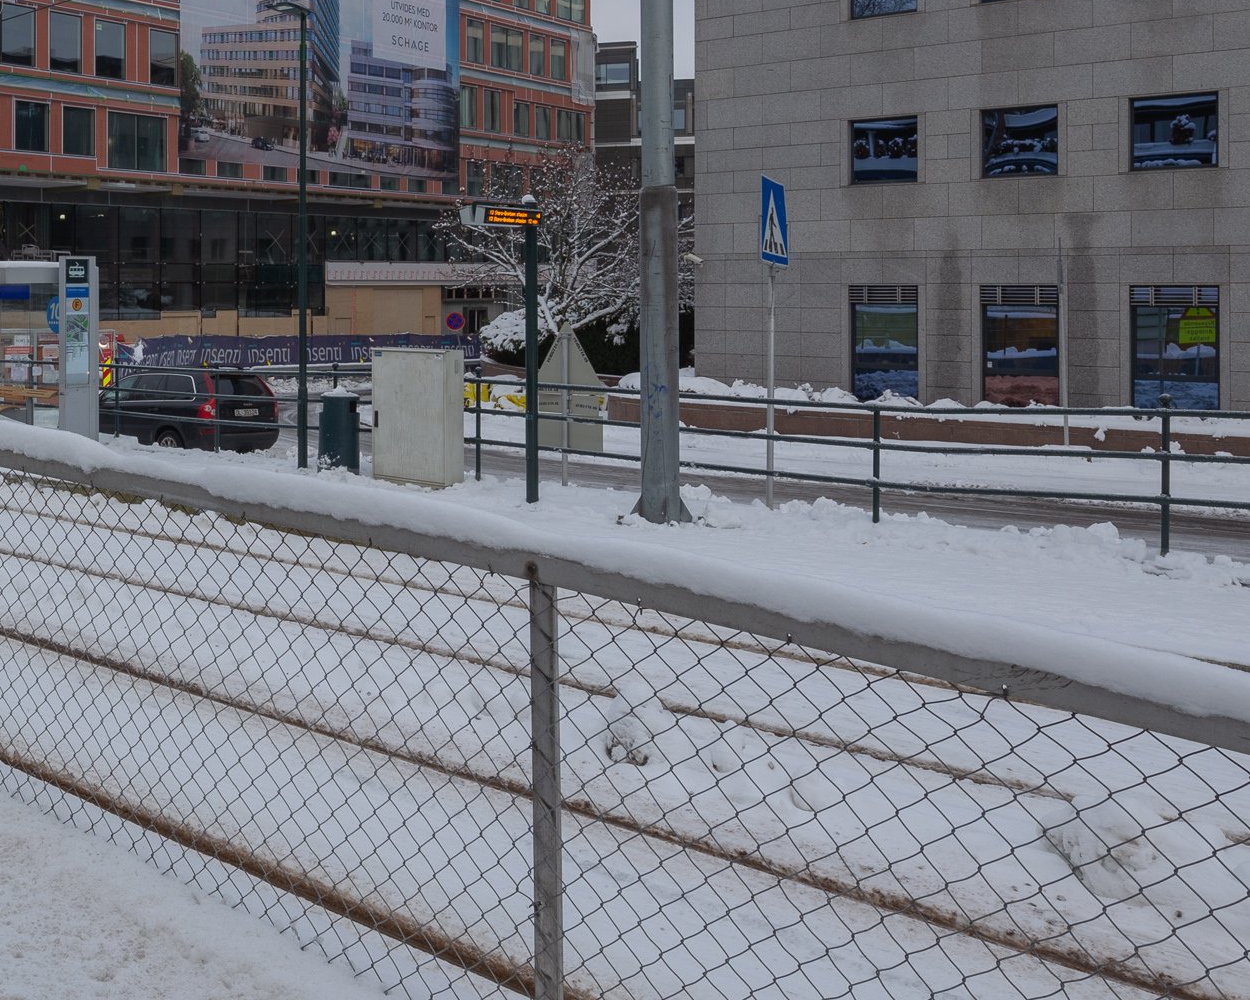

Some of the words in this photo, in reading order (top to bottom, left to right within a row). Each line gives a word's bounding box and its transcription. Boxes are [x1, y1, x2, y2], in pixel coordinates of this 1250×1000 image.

[390, 0, 415, 15] UTVIDES
[416, 7, 430, 18] MED
[382, 12, 403, 25] 20.000
[413, 19, 438, 33] KONTOR
[391, 34, 430, 52] SCHAGE
[306, 345, 342, 362] nsenti
